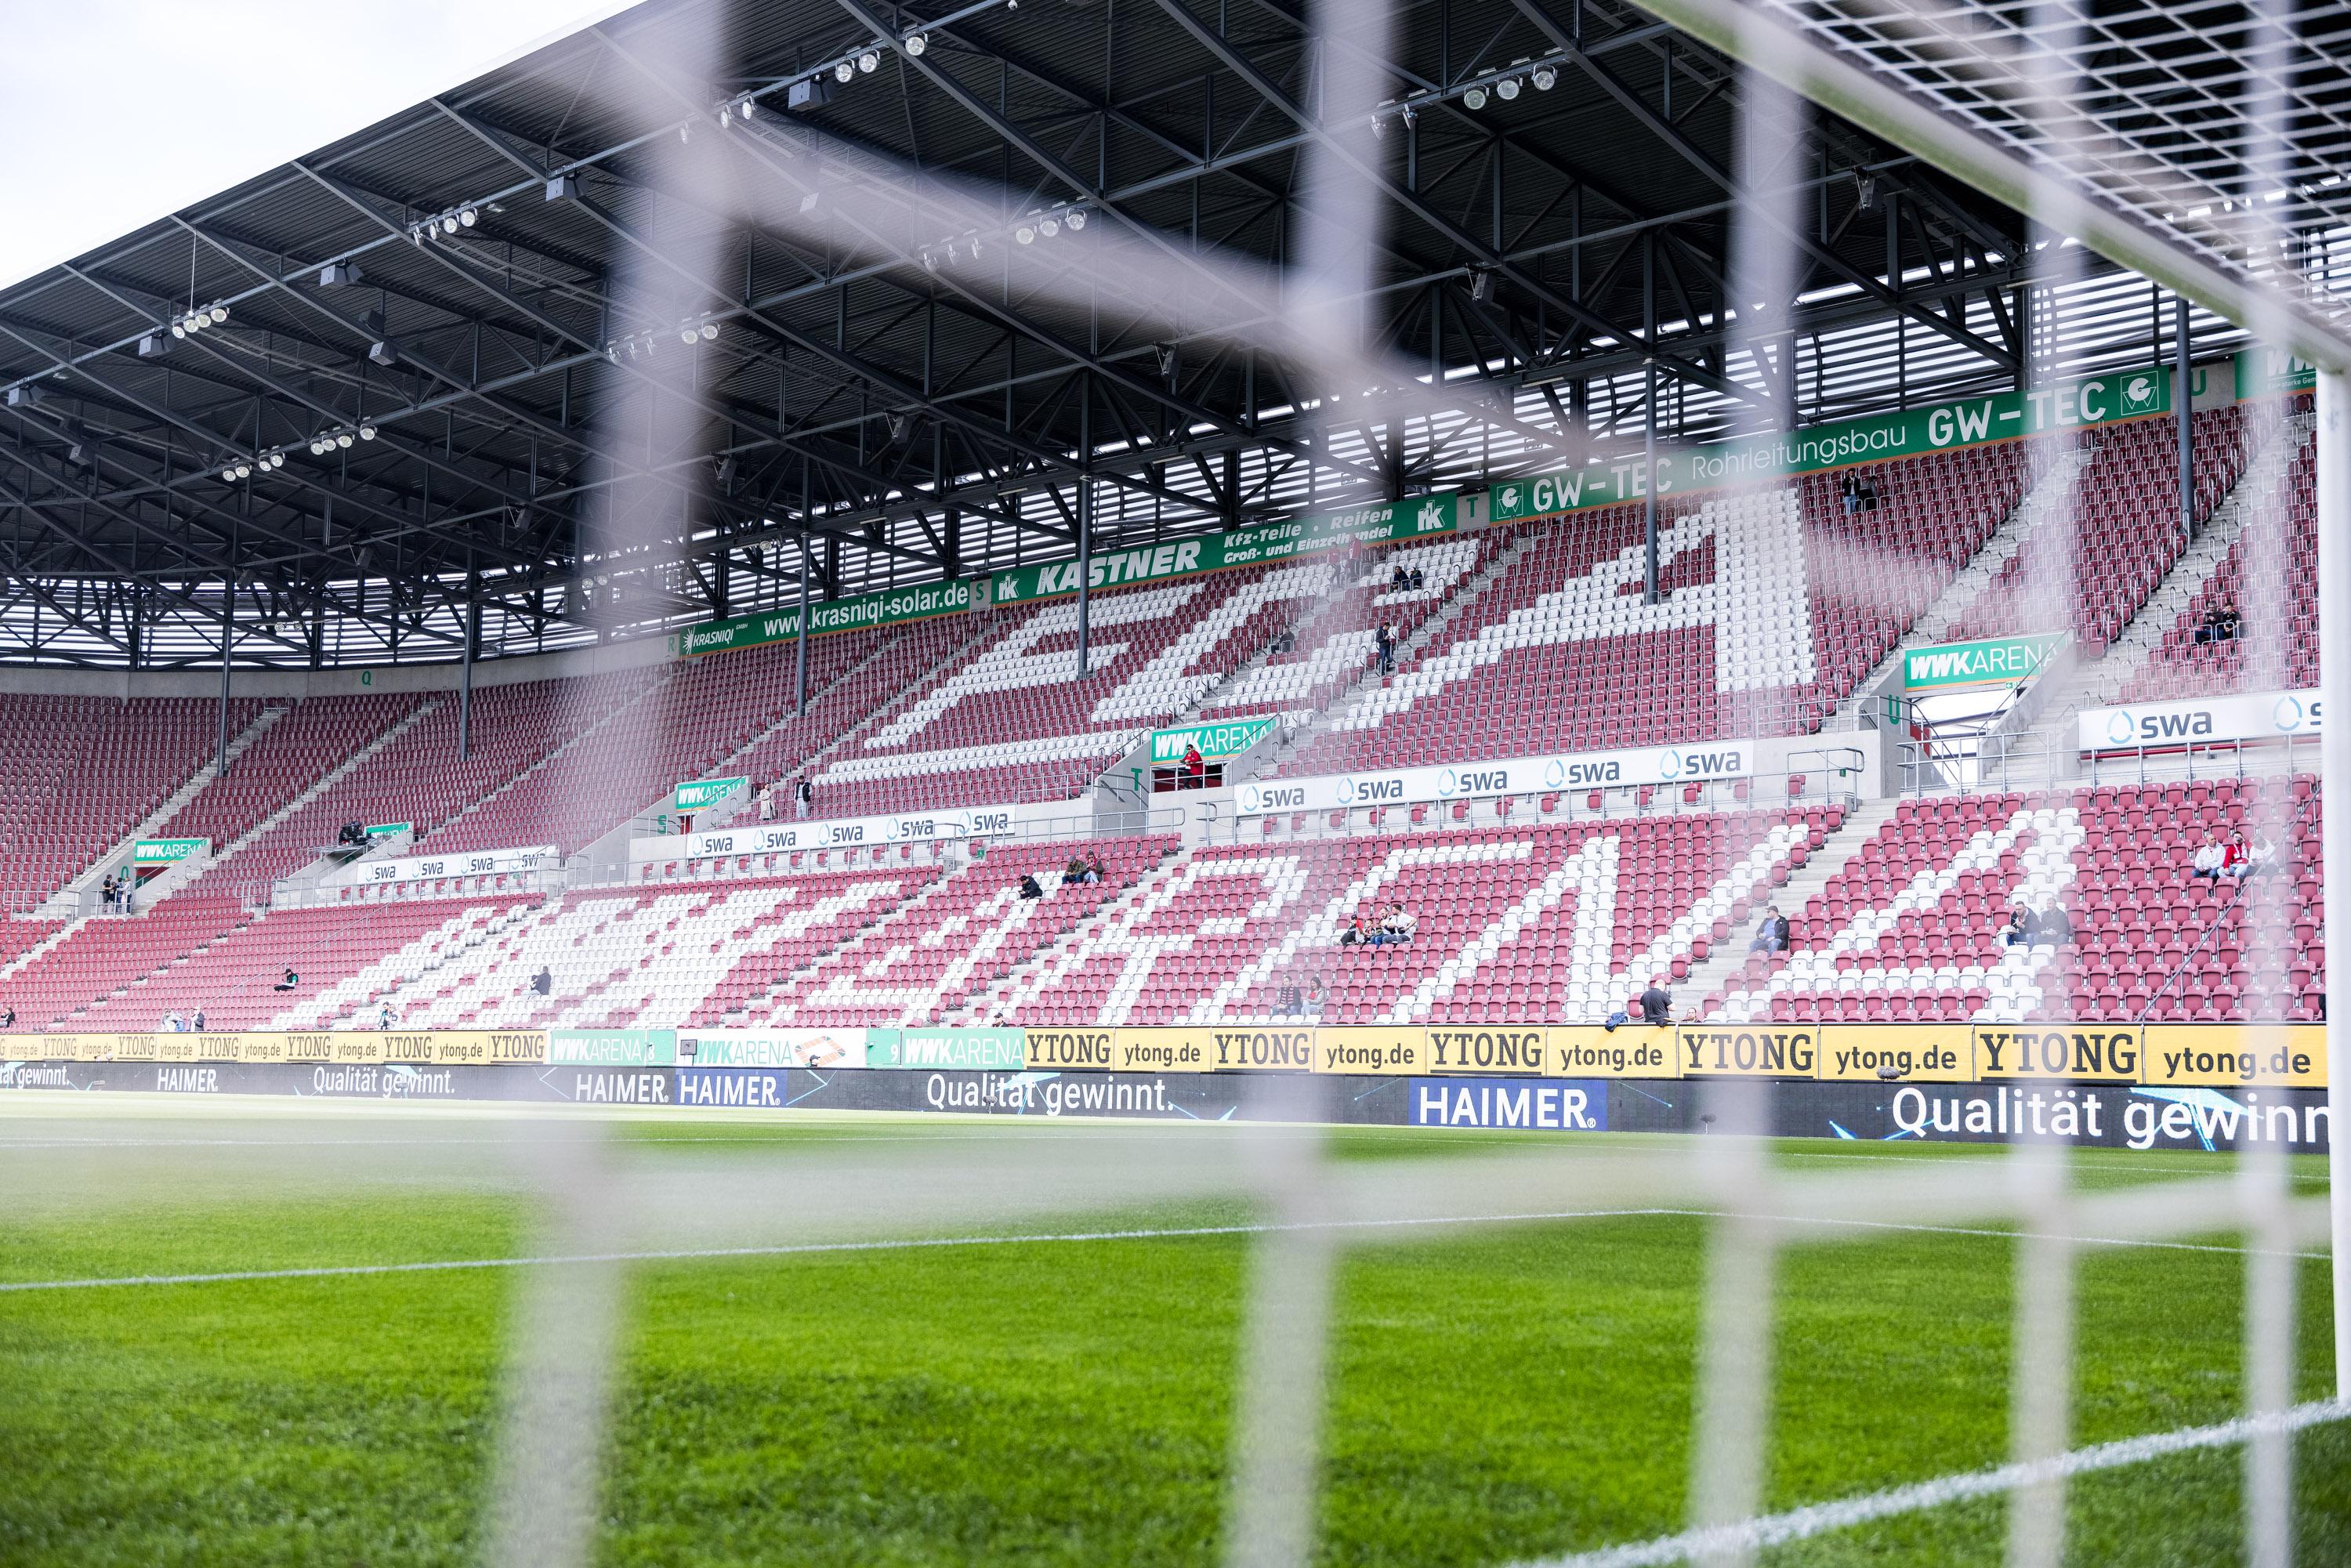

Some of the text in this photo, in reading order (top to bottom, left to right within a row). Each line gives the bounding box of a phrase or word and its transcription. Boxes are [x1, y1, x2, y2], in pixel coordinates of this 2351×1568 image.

[1692, 425, 1906, 480] Rohrleitungsbau
[1466, 497, 1478, 517] T
[1223, 509, 1393, 549] Kfz-Teile Reifen
[1223, 550, 1261, 564] Groß-
[1266, 542, 1293, 557] und
[1036, 541, 1201, 595] KASTNER
[976, 582, 984, 601] S
[668, 636, 676, 653] R
[693, 628, 734, 646] KRASNIQI
[361, 670, 371, 686] Q
[1889, 694, 1900, 725] U
[2140, 711, 2212, 740] swa
[1131, 767, 1143, 791] T
[1262, 751, 1741, 808] swa swa swa swa swa
[705, 813, 1008, 853] swa swa swa swa swa
[375, 865, 396, 879] swa
[422, 861, 444, 875] swa
[470, 857, 494, 871] swa
[118, 1036, 154, 1056] YTONG
[160, 1043, 193, 1059] ytong.de
[199, 1037, 239, 1057] YTONG
[245, 1043, 281, 1059] ytong.de
[288, 1036, 331, 1057] YTONG
[338, 1042, 377, 1059] ytong.de
[385, 1036, 432, 1058] YTONG
[440, 1042, 483, 1061] ytong.de
[491, 1034, 545, 1059] YTONG
[890, 1045, 899, 1062] 9
[1027, 1034, 1110, 1063] YTONG
[1125, 1042, 1201, 1066] ytong.de
[1215, 1033, 1310, 1065] YTONG
[1327, 1043, 1415, 1069] ytong.de
[1431, 1033, 1541, 1067] YTONG
[1561, 1043, 1663, 1071] ytong.de
[1683, 1034, 1813, 1070] YTONG
[1980, 1033, 2137, 1074] YTONG
[1835, 1045, 1957, 1075] ytong.de
[2163, 1045, 2311, 1080] ytong.de
[18, 1063, 70, 1089] gewinnt.
[313, 1066, 455, 1098] Qualität gewinnt.
[927, 1073, 1174, 1116] Qualität gewinnt.
[1891, 1086, 2329, 1150] Qualität gewinn
